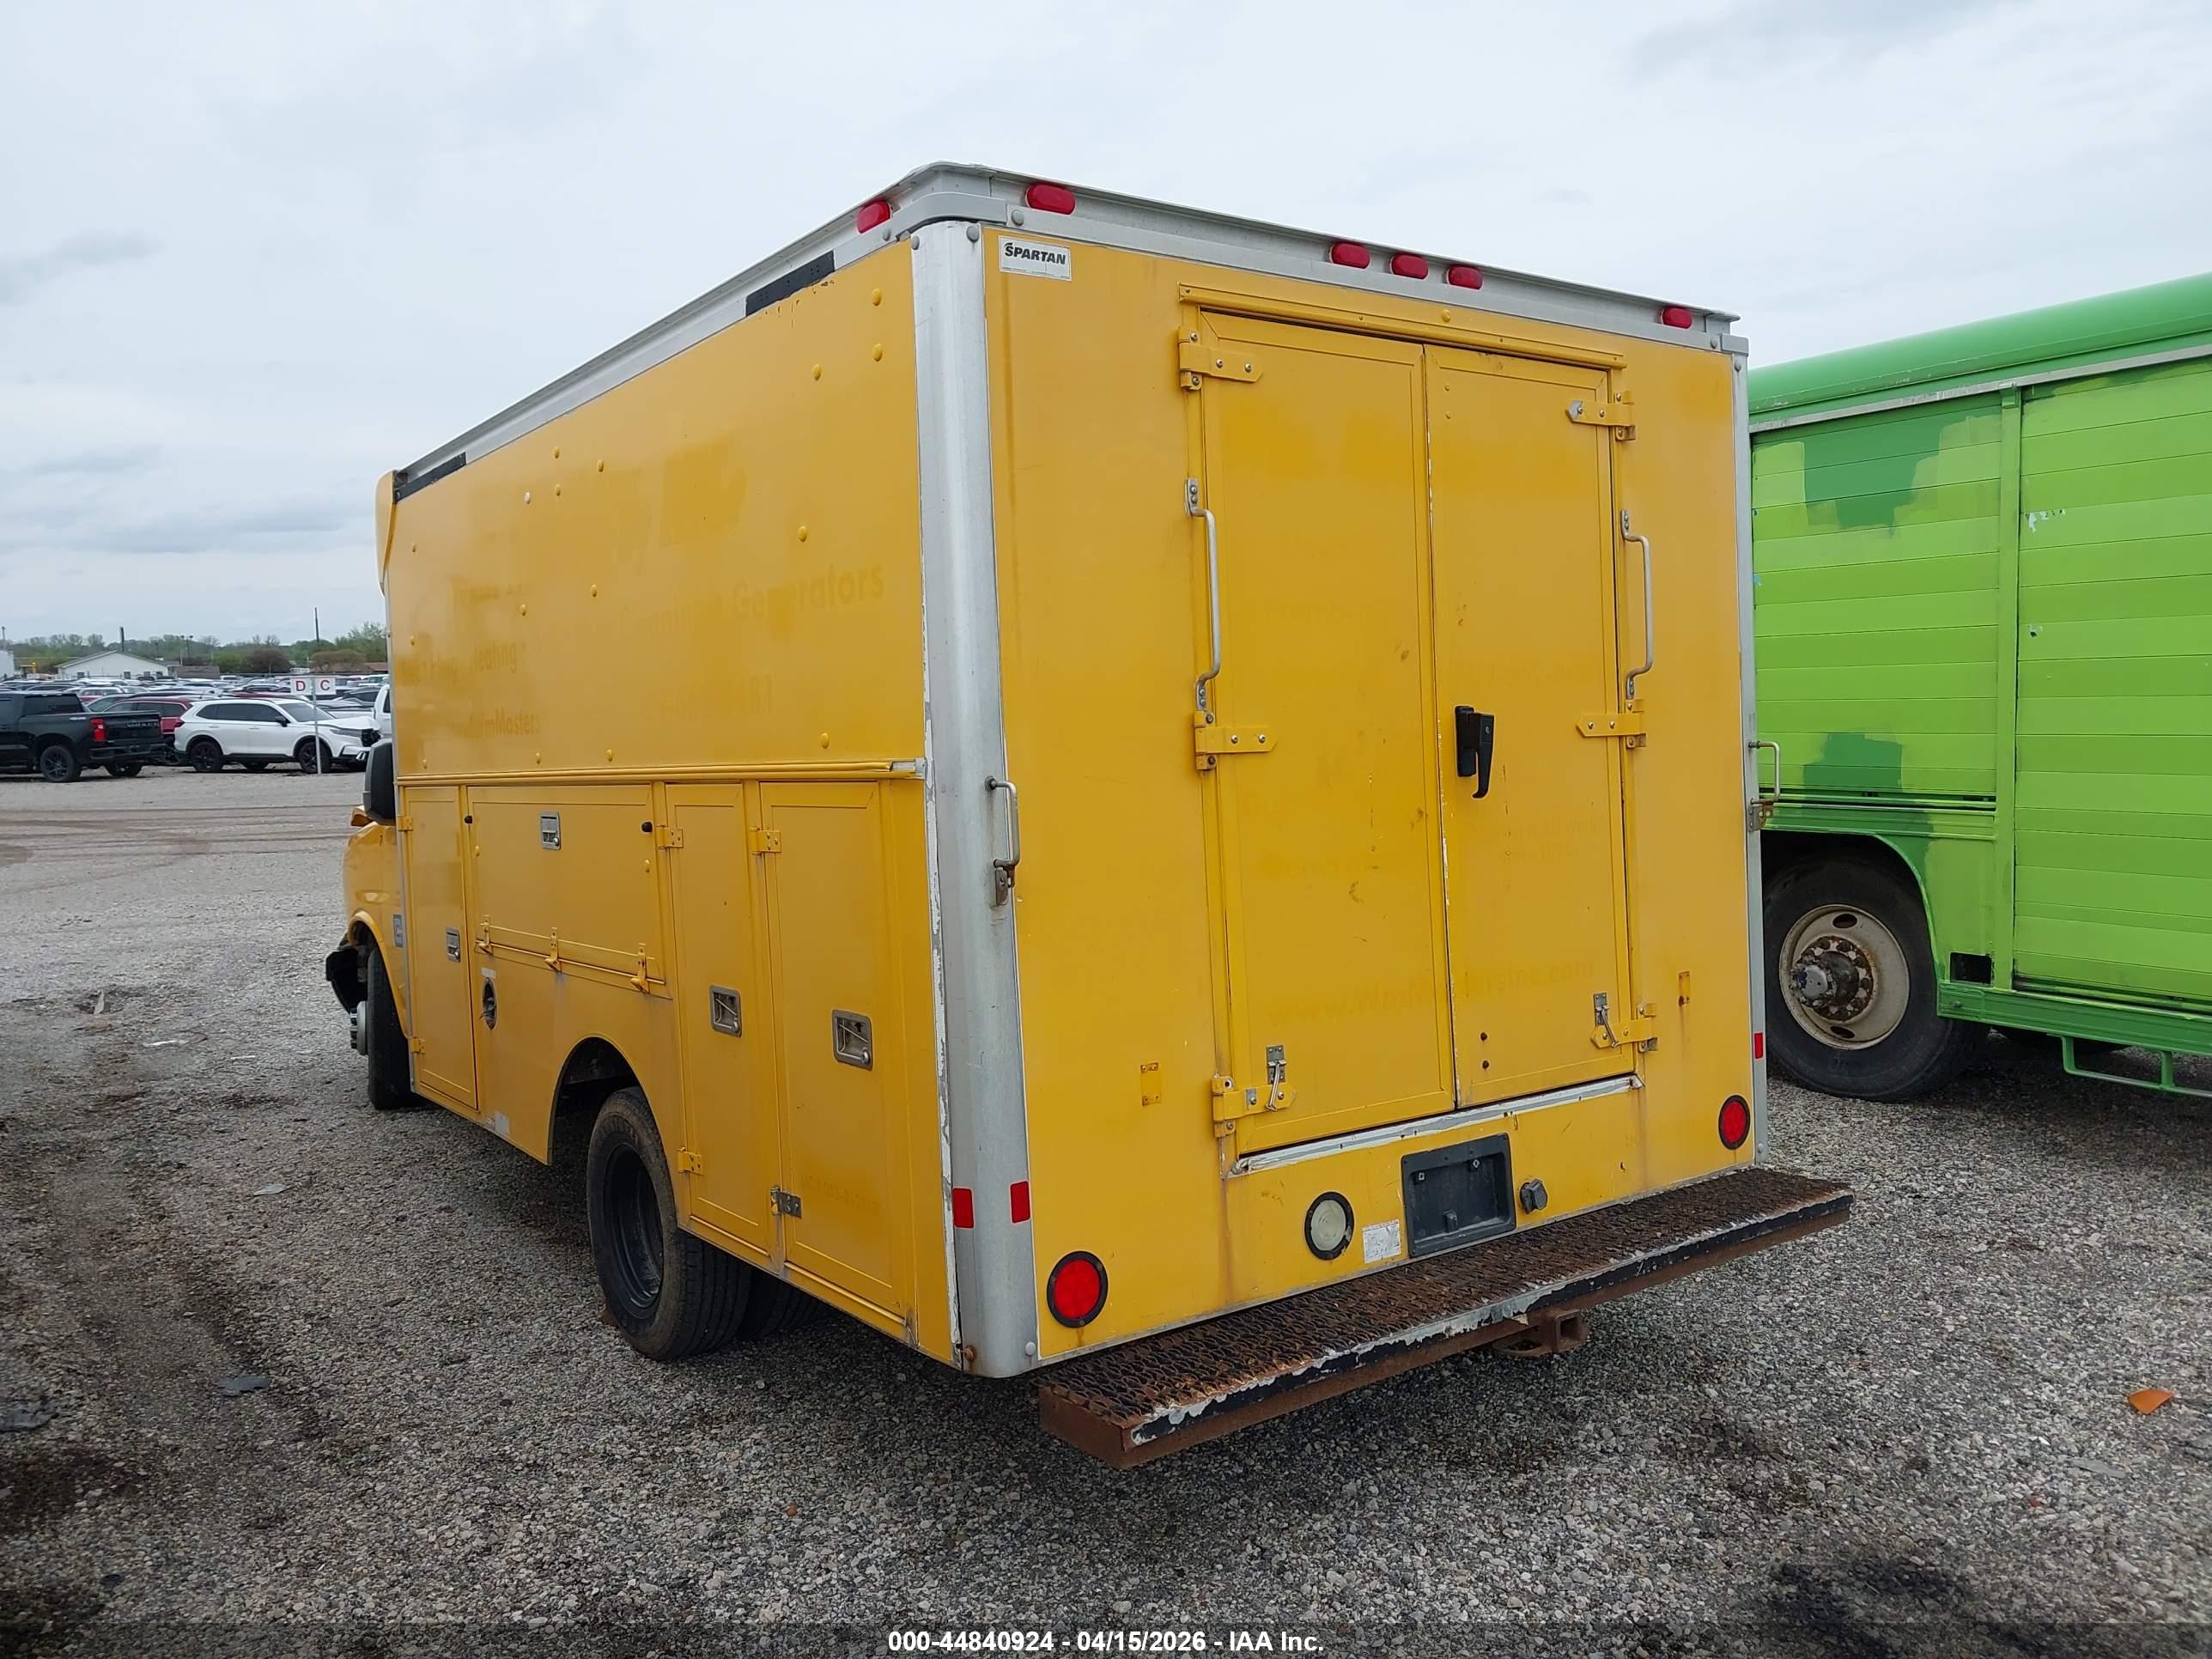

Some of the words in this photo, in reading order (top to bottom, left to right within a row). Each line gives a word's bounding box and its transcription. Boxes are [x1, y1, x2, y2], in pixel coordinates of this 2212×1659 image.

[1004, 242, 1066, 264] SPARTAN
[295, 680, 306, 691] D
[320, 679, 331, 690] C
